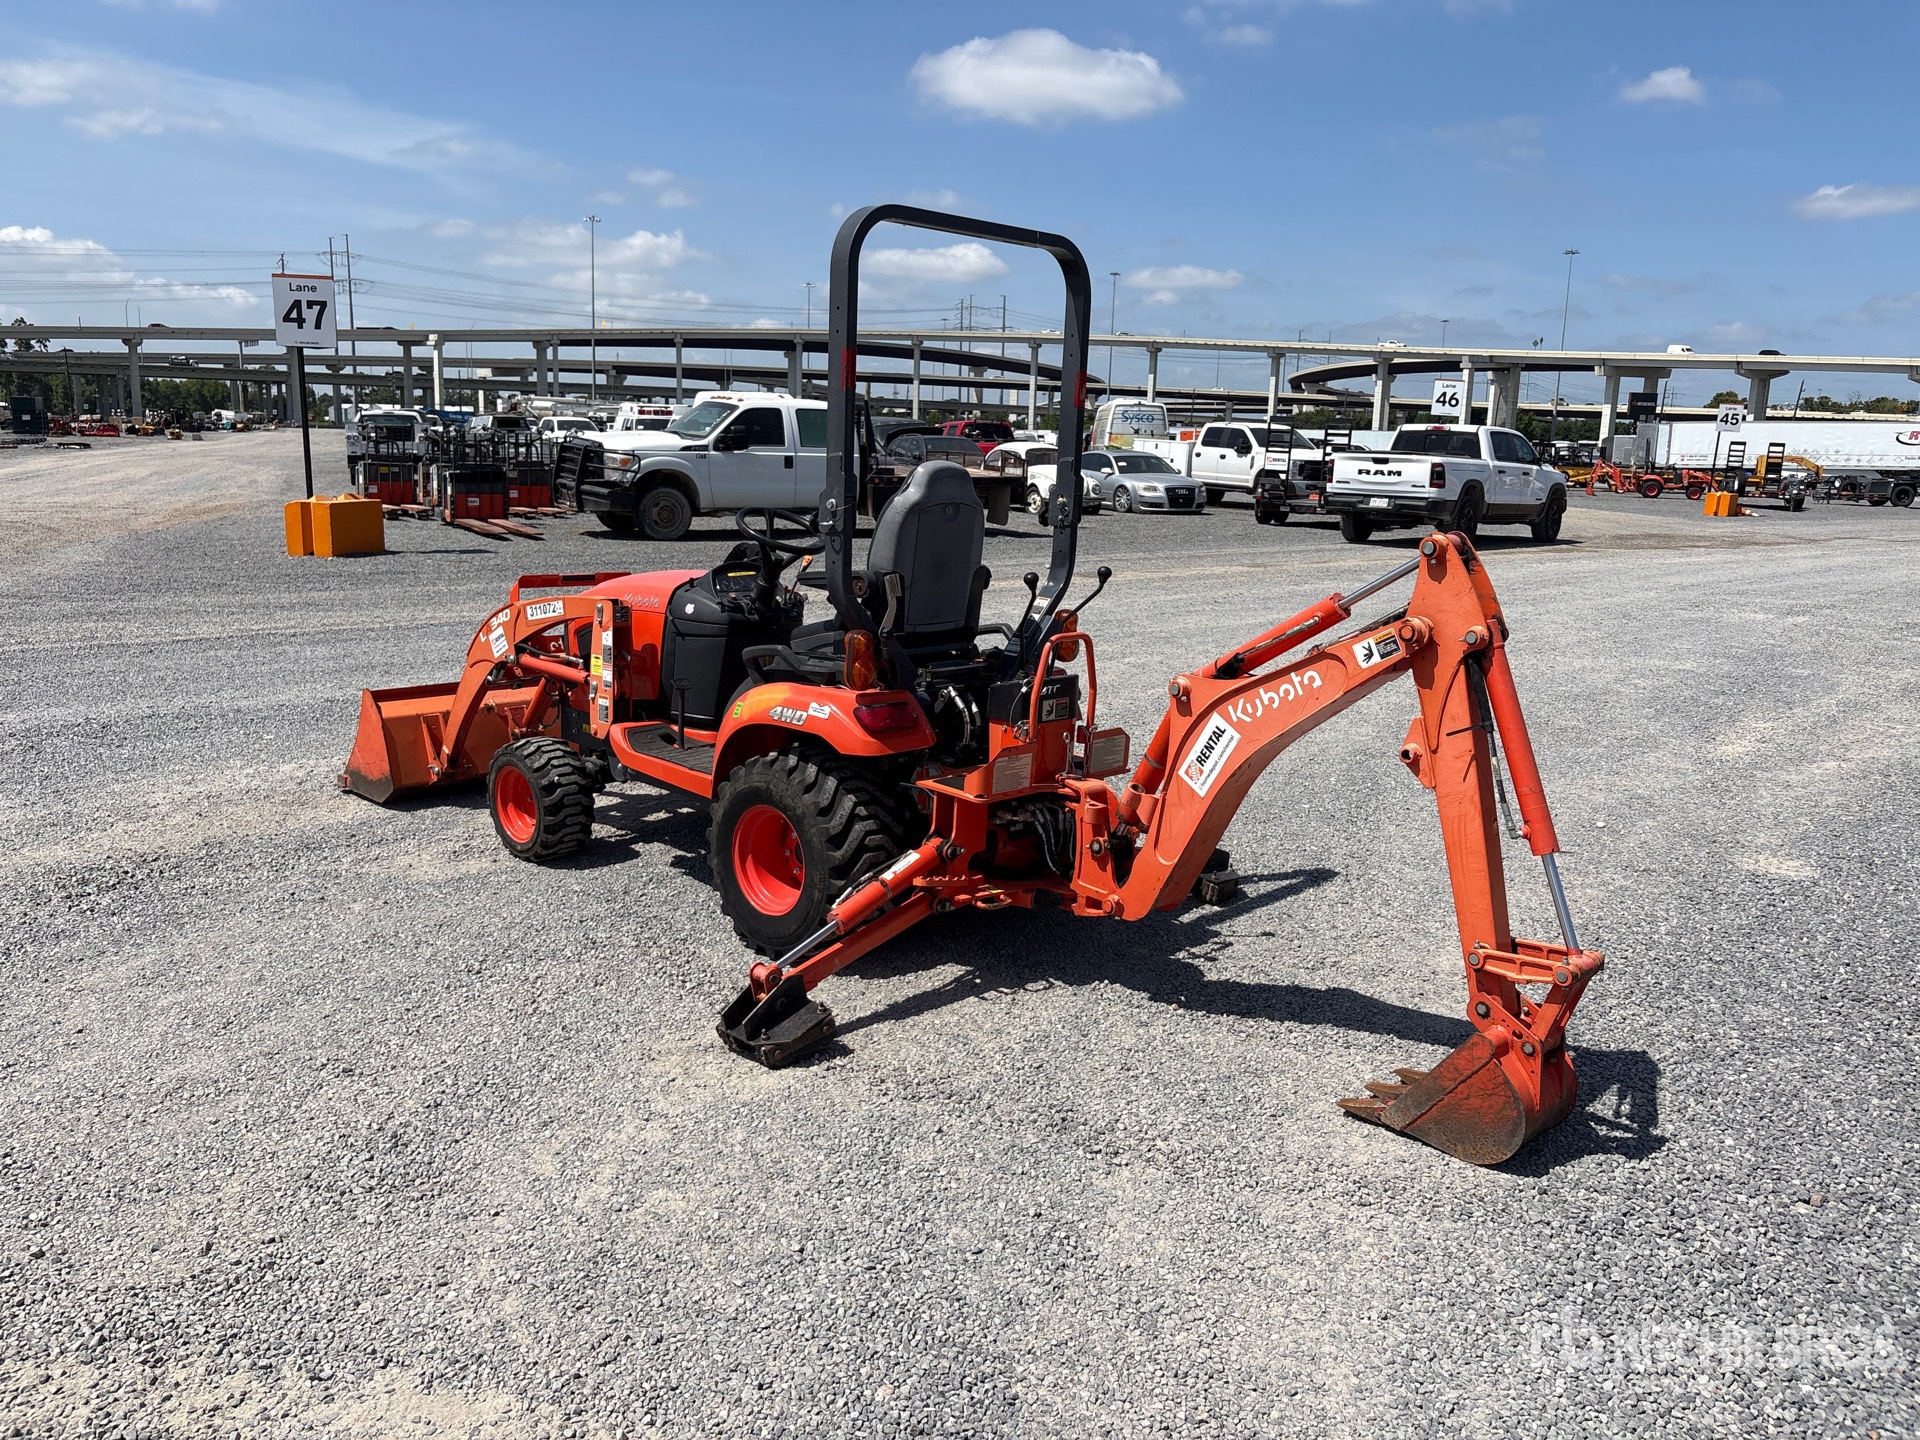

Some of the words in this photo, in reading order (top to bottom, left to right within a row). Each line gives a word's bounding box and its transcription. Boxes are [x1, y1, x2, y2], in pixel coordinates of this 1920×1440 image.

[289, 282, 317, 292] Lane
[282, 299, 328, 330] 47
[1435, 391, 1459, 407] 46
[1121, 410, 1155, 425] Sysco
[1719, 412, 1739, 425] 45
[1358, 469, 1402, 477] RAM
[624, 593, 660, 608] Kubota
[1227, 670, 1323, 723] Kubota
[768, 705, 808, 726] 4WD
[1195, 725, 1227, 768] RENTAL
[1200, 734, 1235, 787] homedepot.com/rental
